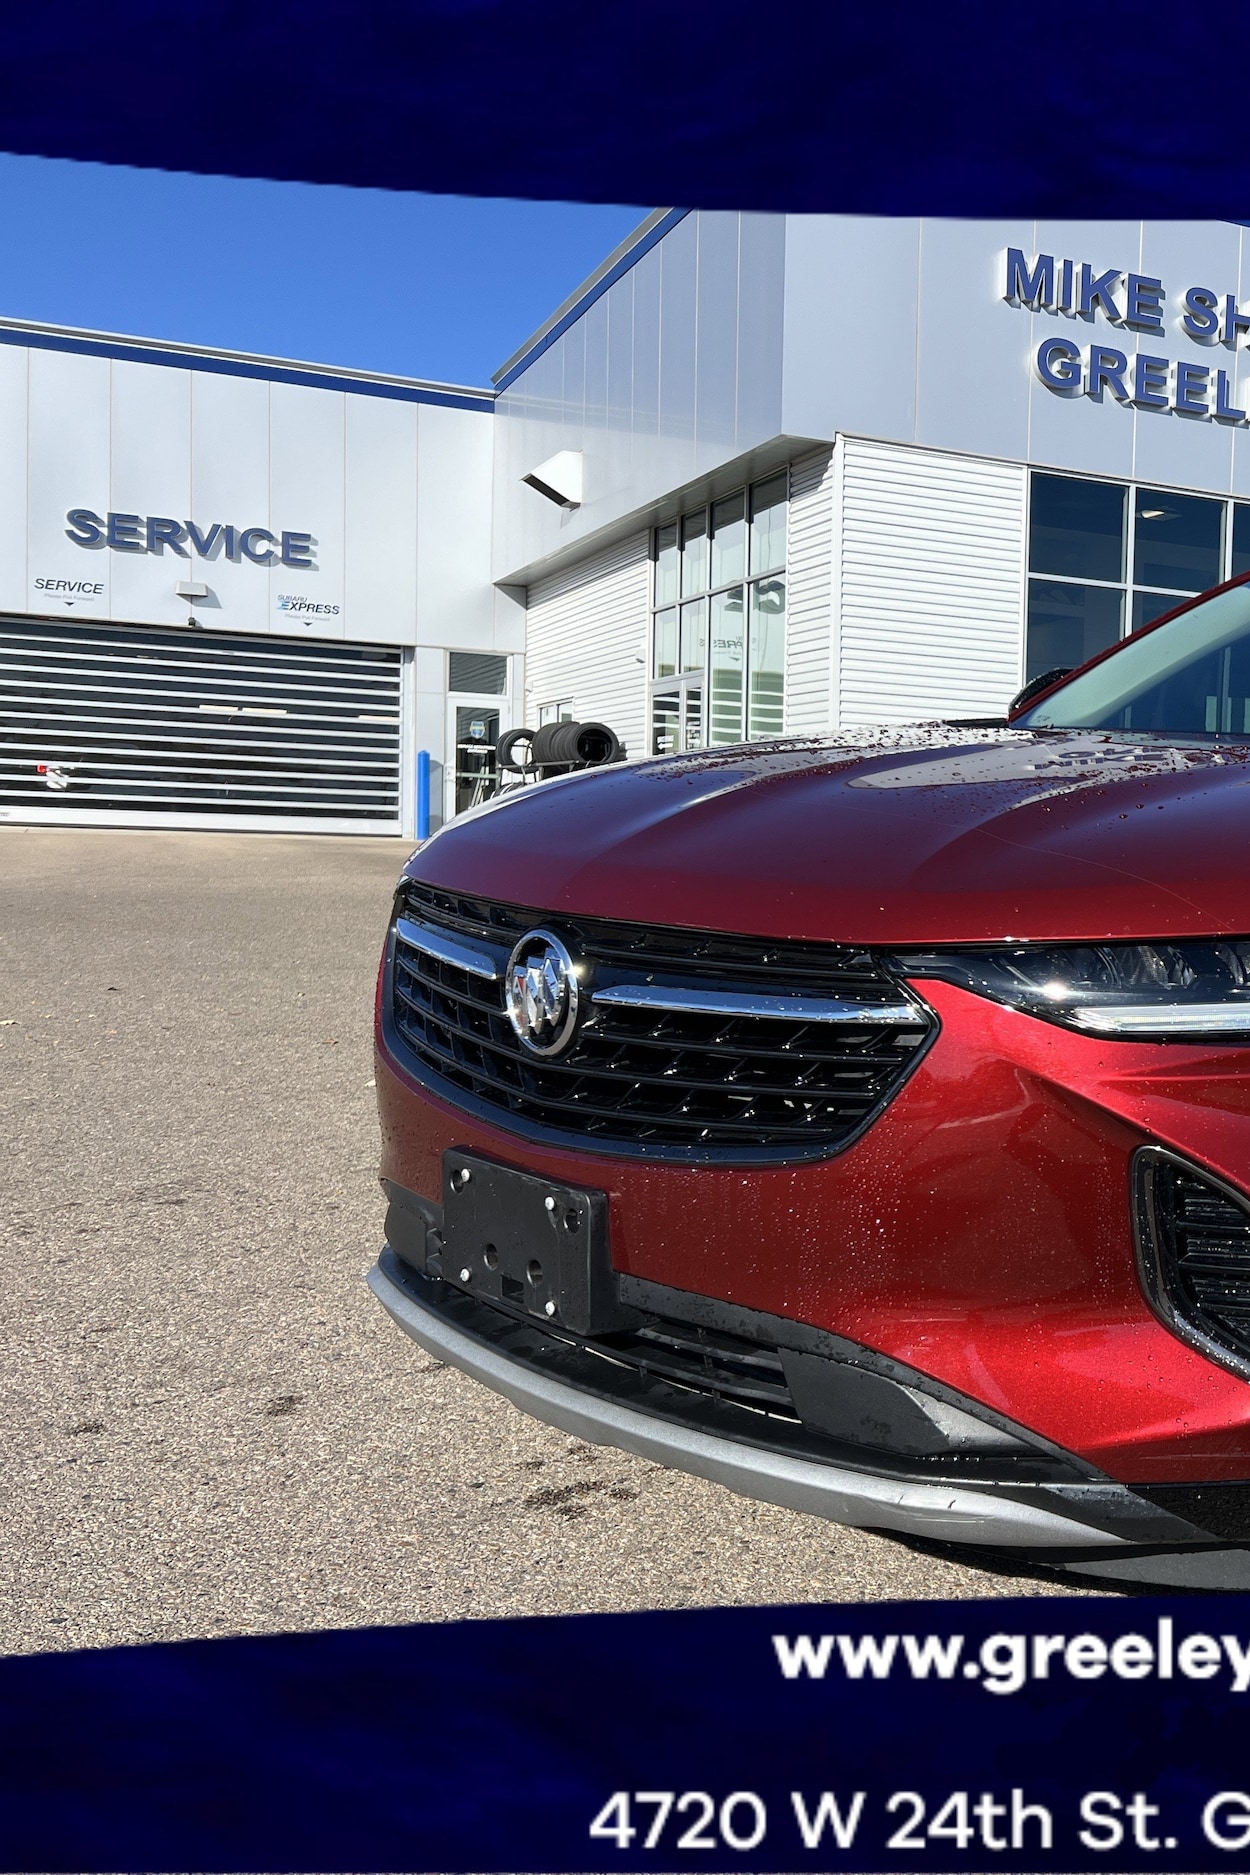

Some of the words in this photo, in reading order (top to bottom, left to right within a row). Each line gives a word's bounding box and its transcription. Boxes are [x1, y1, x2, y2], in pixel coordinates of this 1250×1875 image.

[1003, 247, 1163, 328] MIKE
[65, 508, 314, 567] SERVICE
[34, 578, 105, 595] SERVICE
[278, 600, 341, 615] EXPRESS
